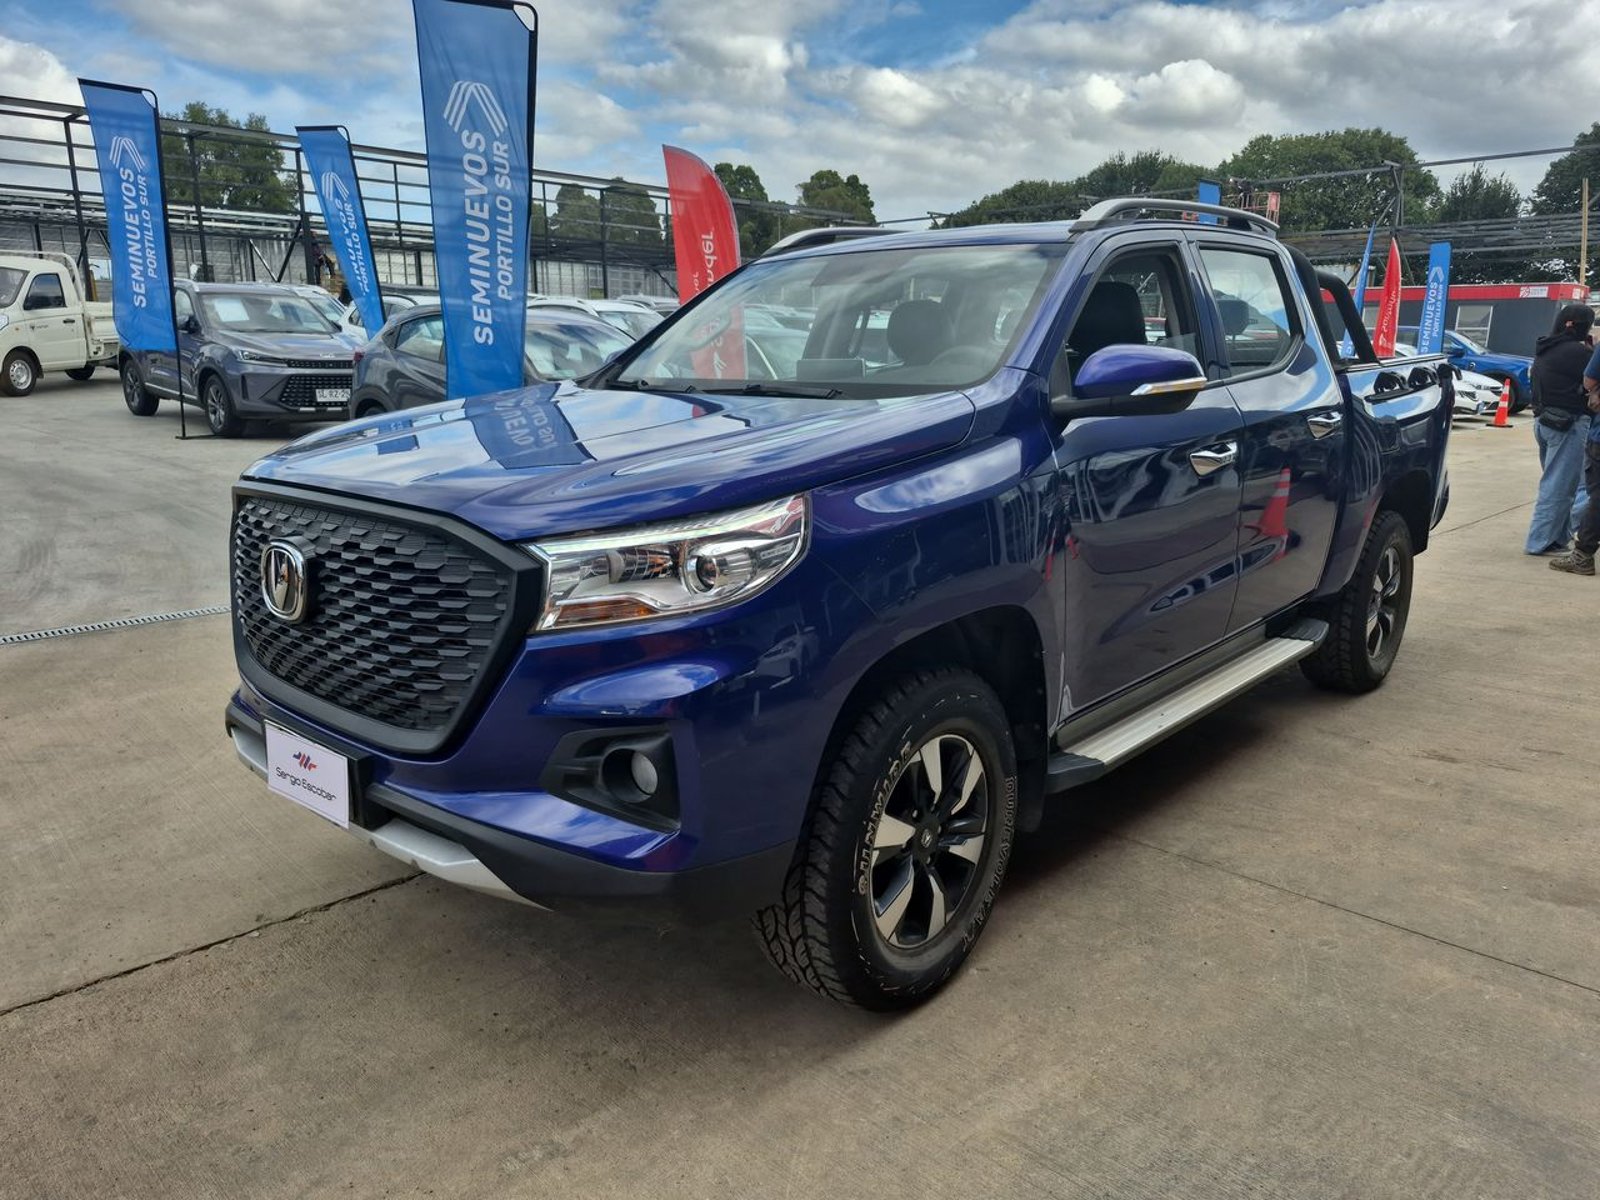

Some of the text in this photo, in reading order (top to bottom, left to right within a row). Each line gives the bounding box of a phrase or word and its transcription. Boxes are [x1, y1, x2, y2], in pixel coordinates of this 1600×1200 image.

[120, 168, 146, 308] SEMINUEVOS
[137, 174, 158, 278] PORTILLO SUR
[344, 203, 370, 293] PORTILLO SUR
[461, 129, 494, 346] SEMINUEVOS
[492, 141, 514, 301] PORTILLO SUR
[1420, 281, 1438, 354] SEMINUEVOS
[302, 778, 336, 800] Escobar
